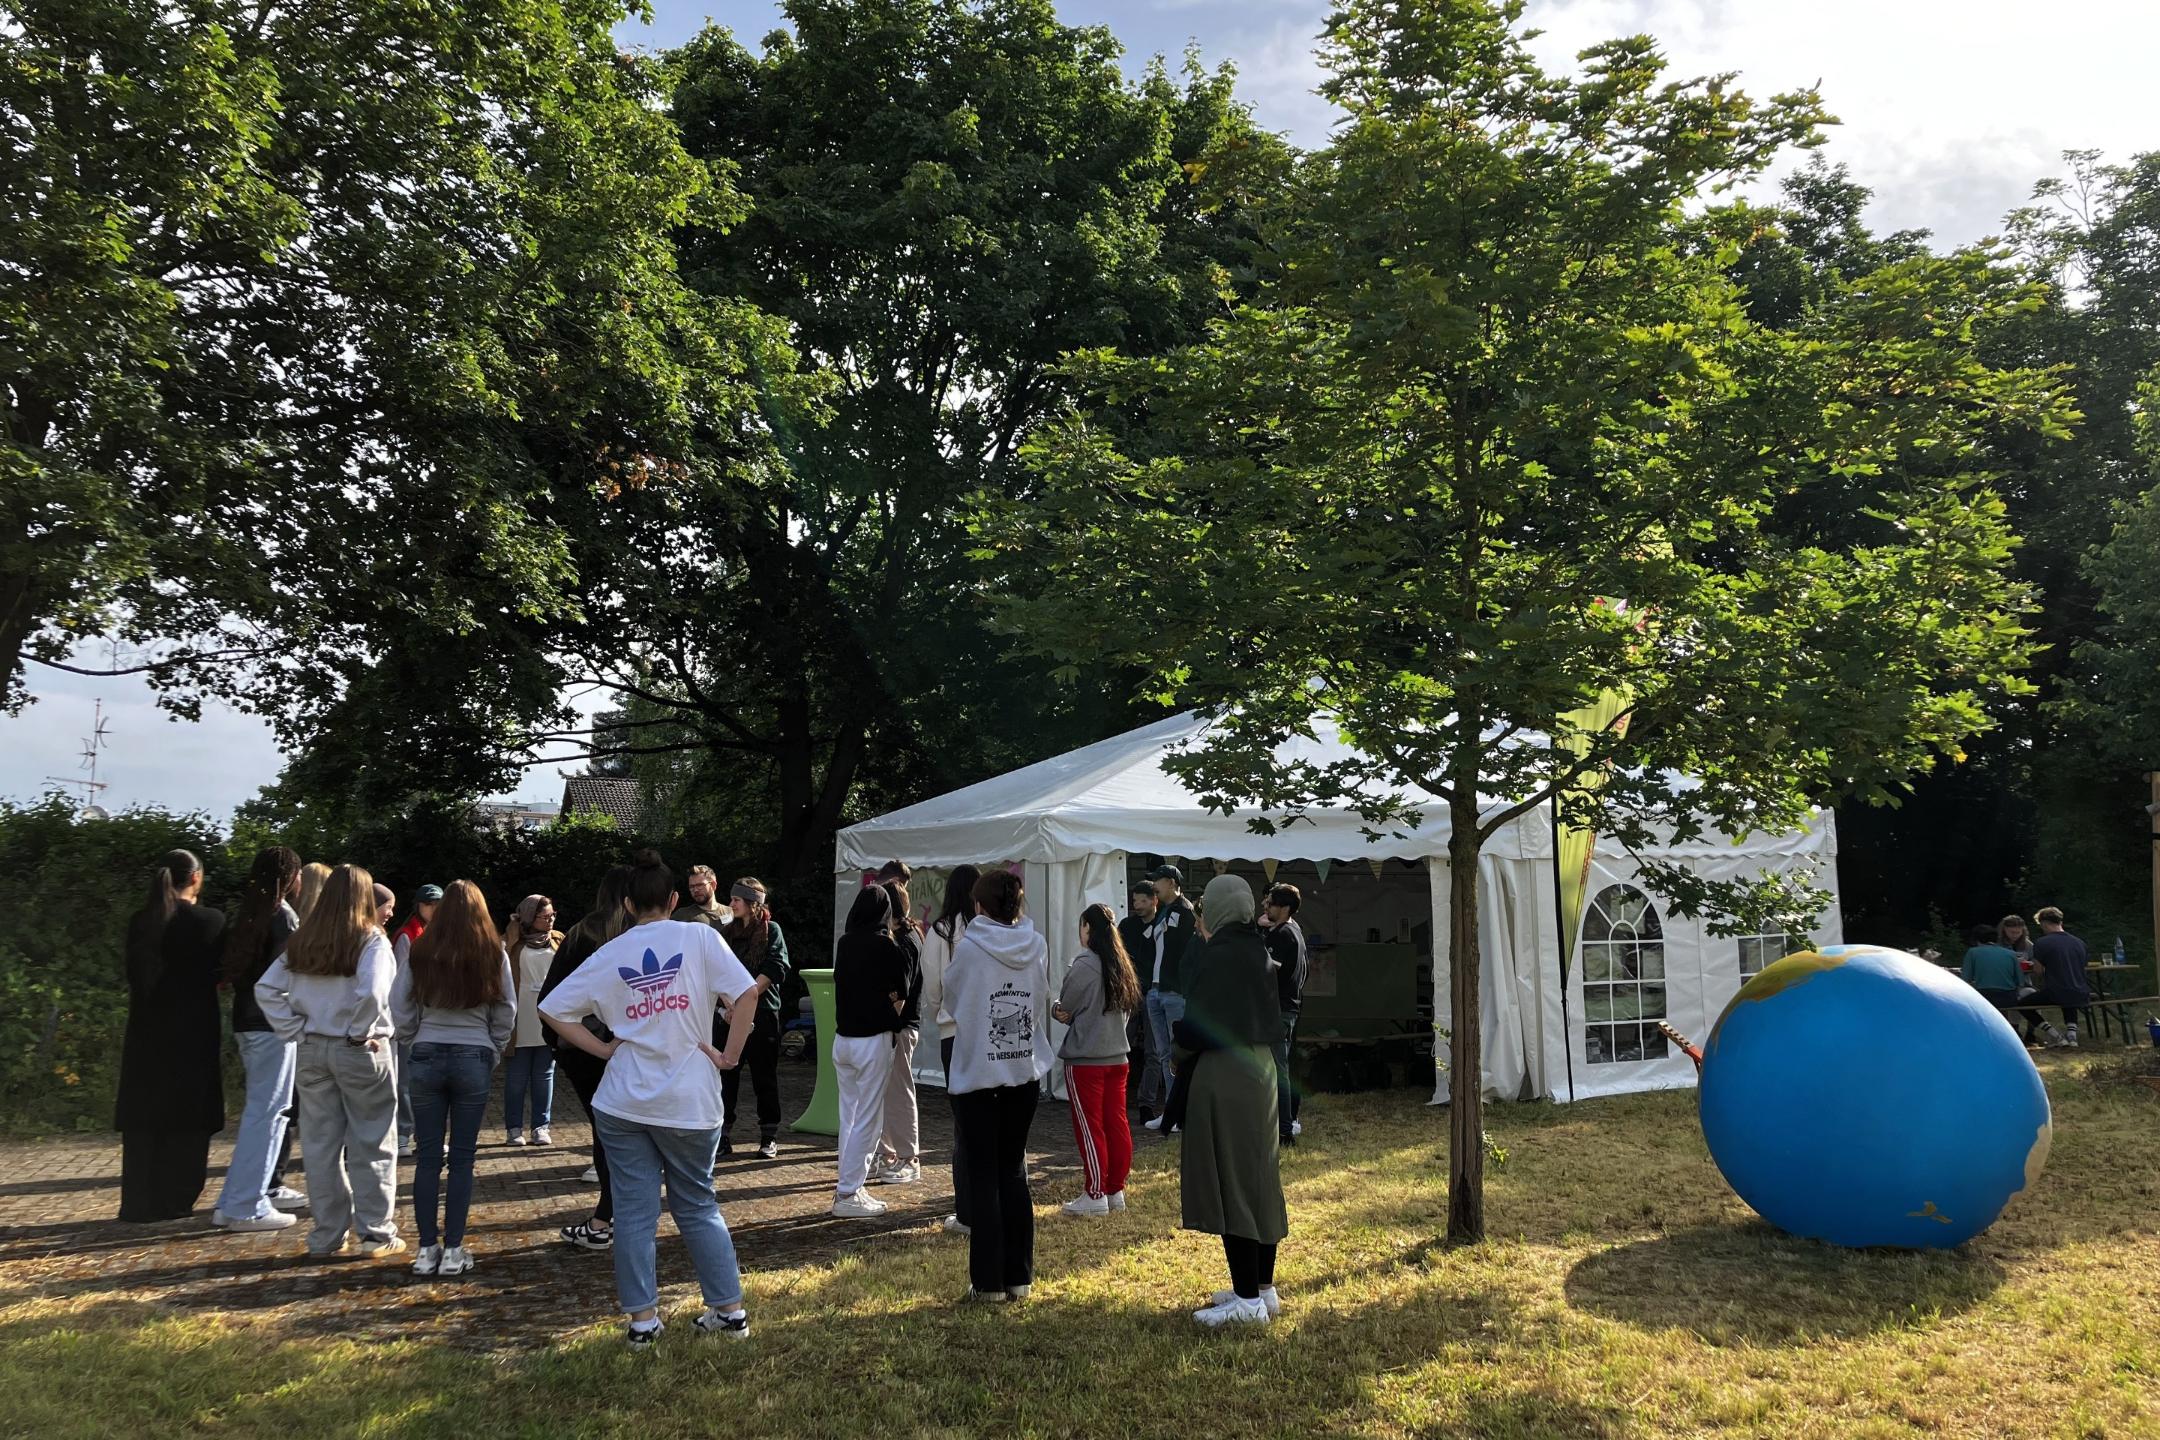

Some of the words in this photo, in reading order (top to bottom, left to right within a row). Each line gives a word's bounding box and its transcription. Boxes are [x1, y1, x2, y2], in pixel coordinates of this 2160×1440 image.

[989, 990, 1031, 1001] BADMINTON
[625, 993, 690, 1020] adidas
[987, 1053, 996, 1061] TG
